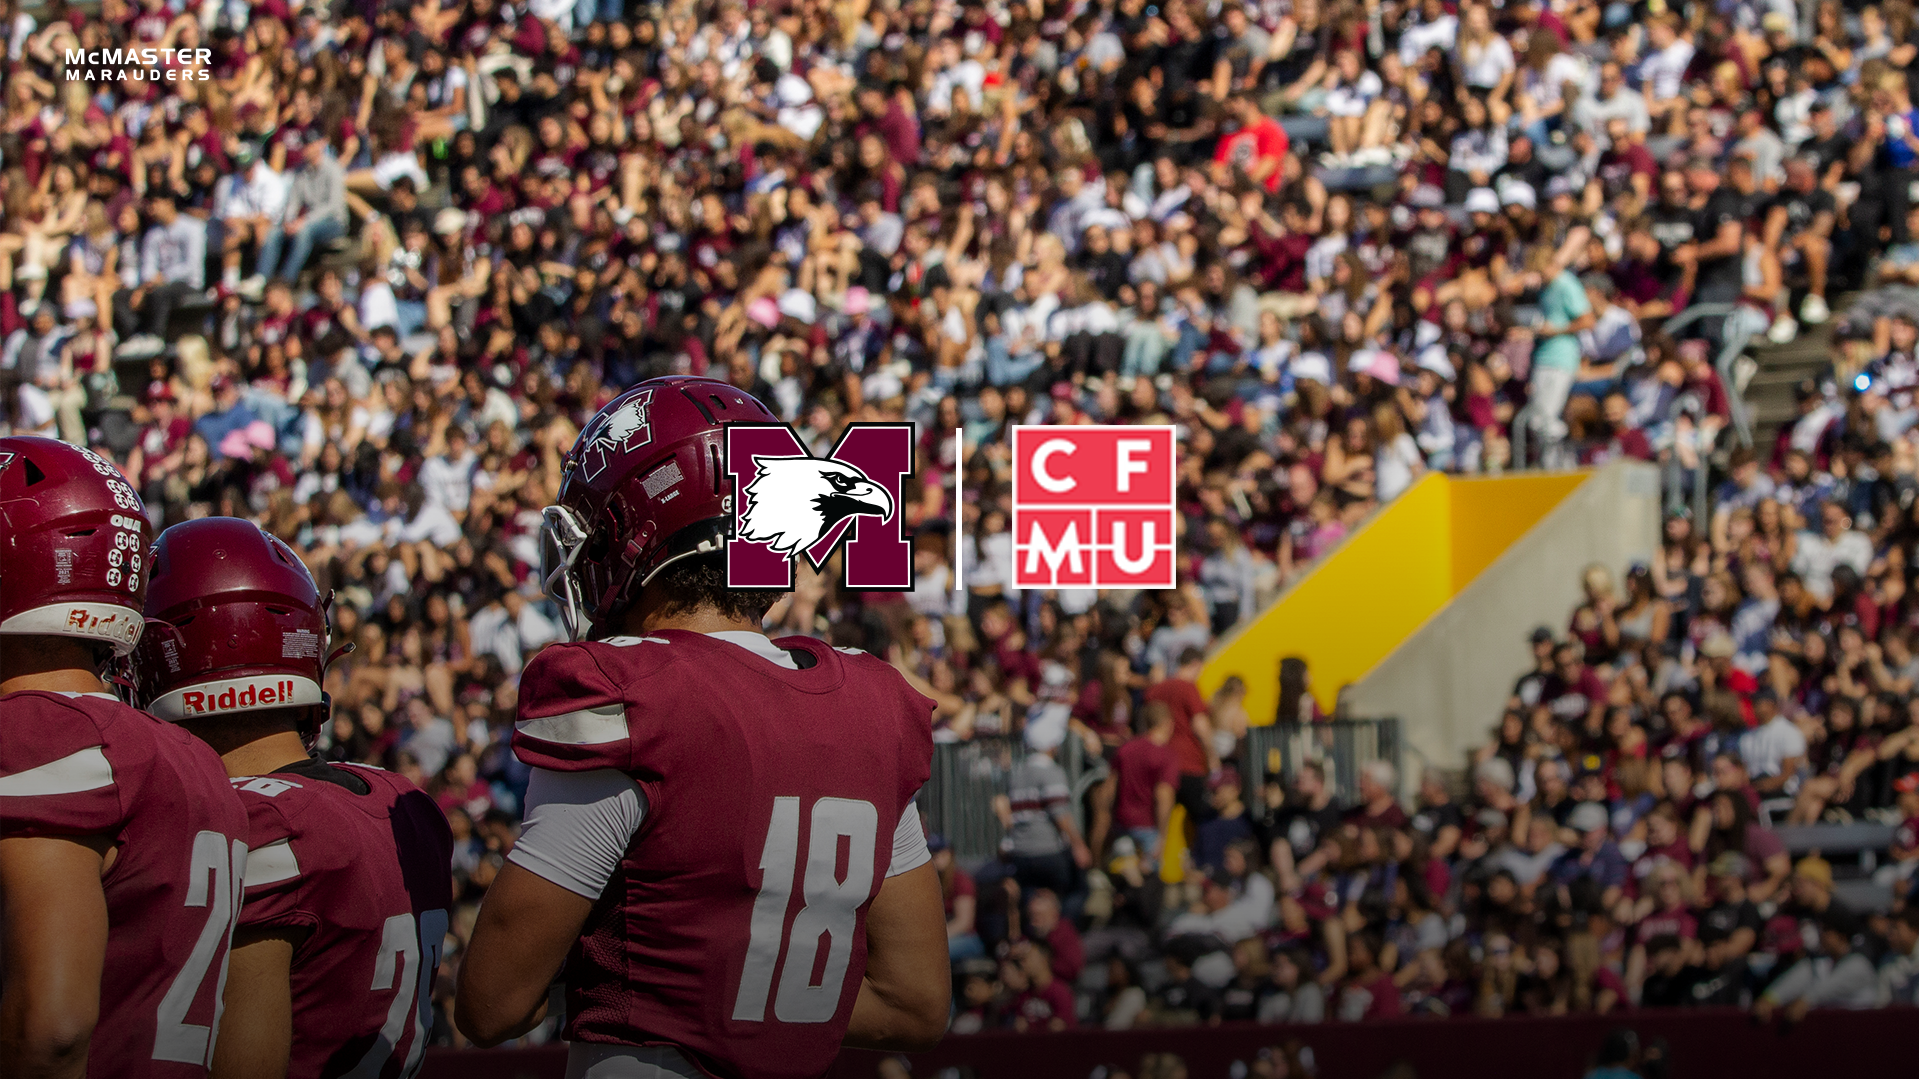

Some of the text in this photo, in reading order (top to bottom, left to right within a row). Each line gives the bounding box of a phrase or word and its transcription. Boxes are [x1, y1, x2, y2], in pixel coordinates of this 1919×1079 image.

[110, 514, 142, 533] OUA
[62, 607, 144, 645] Riddell
[182, 680, 294, 716] Riddell
[731, 796, 878, 1024] 18
